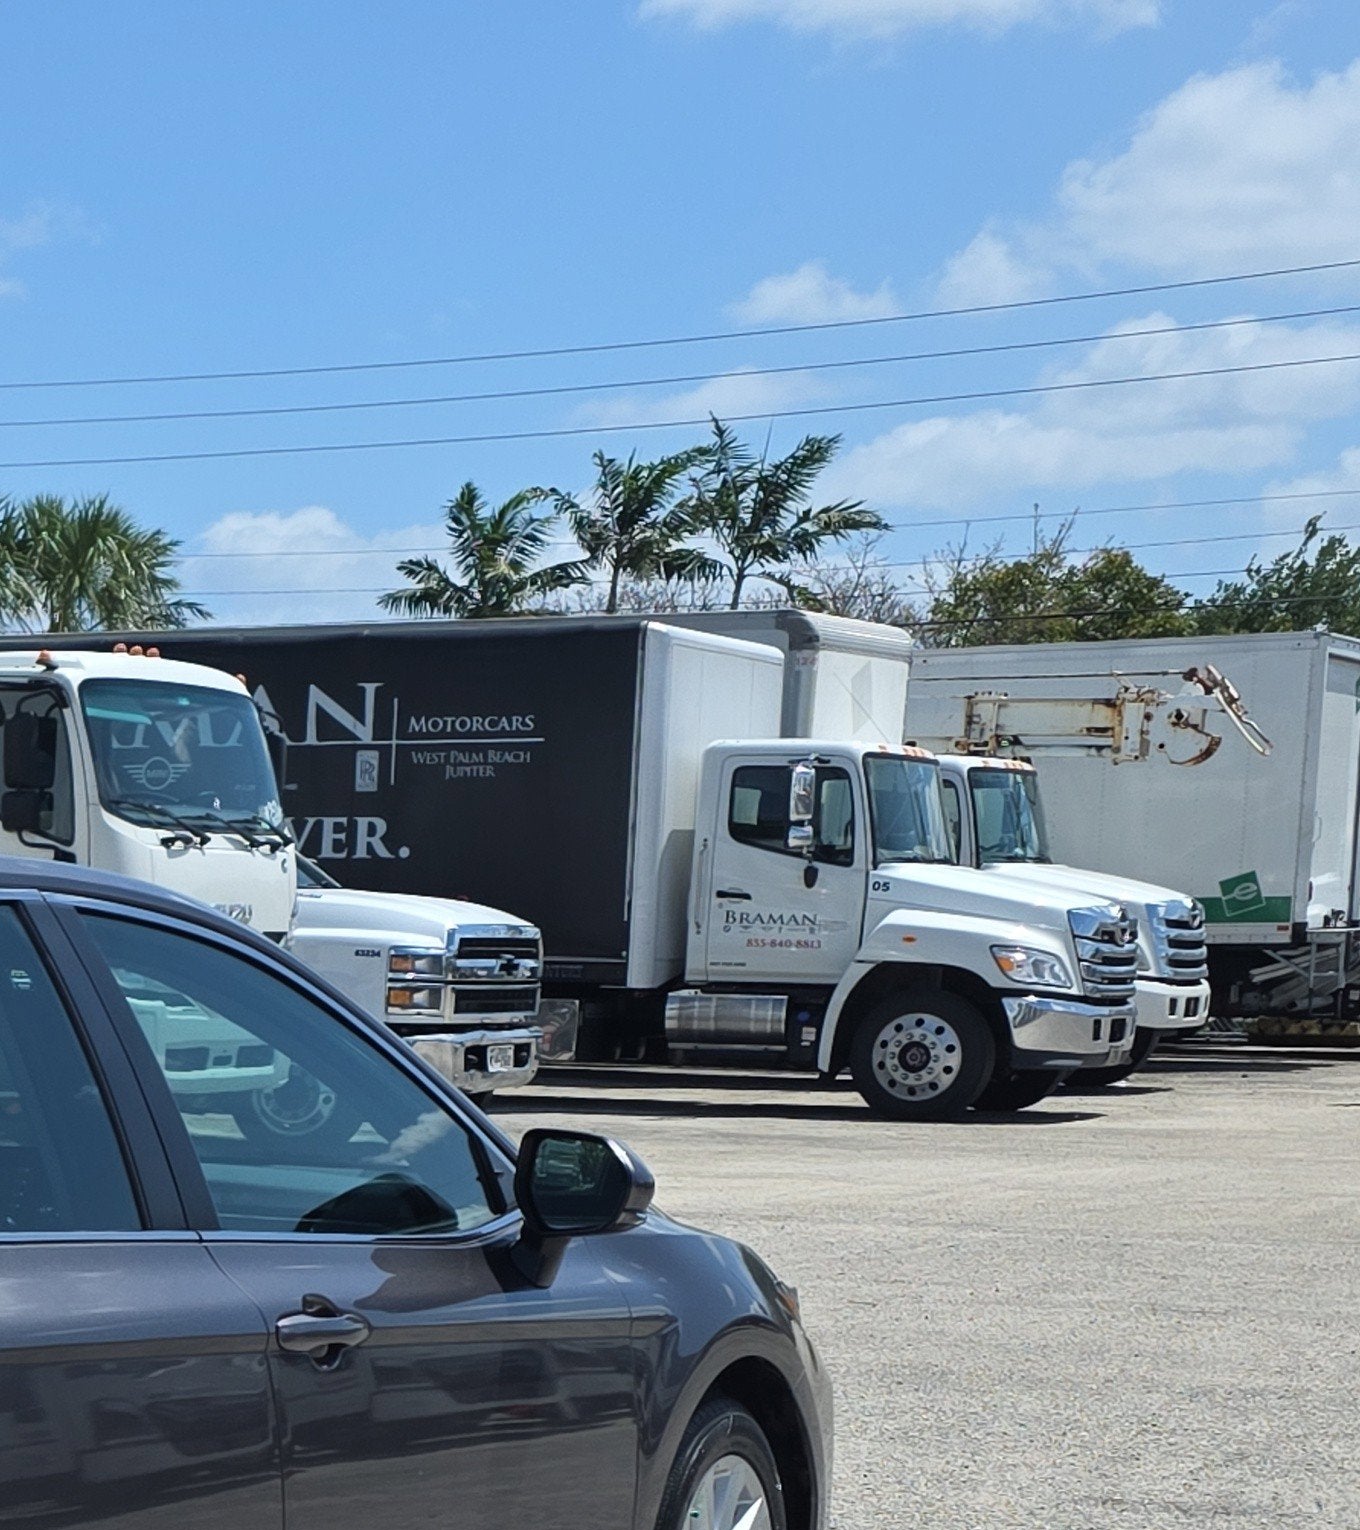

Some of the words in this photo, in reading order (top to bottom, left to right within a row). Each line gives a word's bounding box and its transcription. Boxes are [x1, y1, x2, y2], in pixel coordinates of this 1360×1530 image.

[408, 715, 535, 733] MOTORCARS
[411, 751, 447, 765] WEST
[450, 750, 484, 764] PALM
[487, 750, 531, 764] BEACH
[445, 765, 496, 780] JUPITER
[872, 881, 890, 892] 05
[725, 910, 818, 926] BRAMAN
